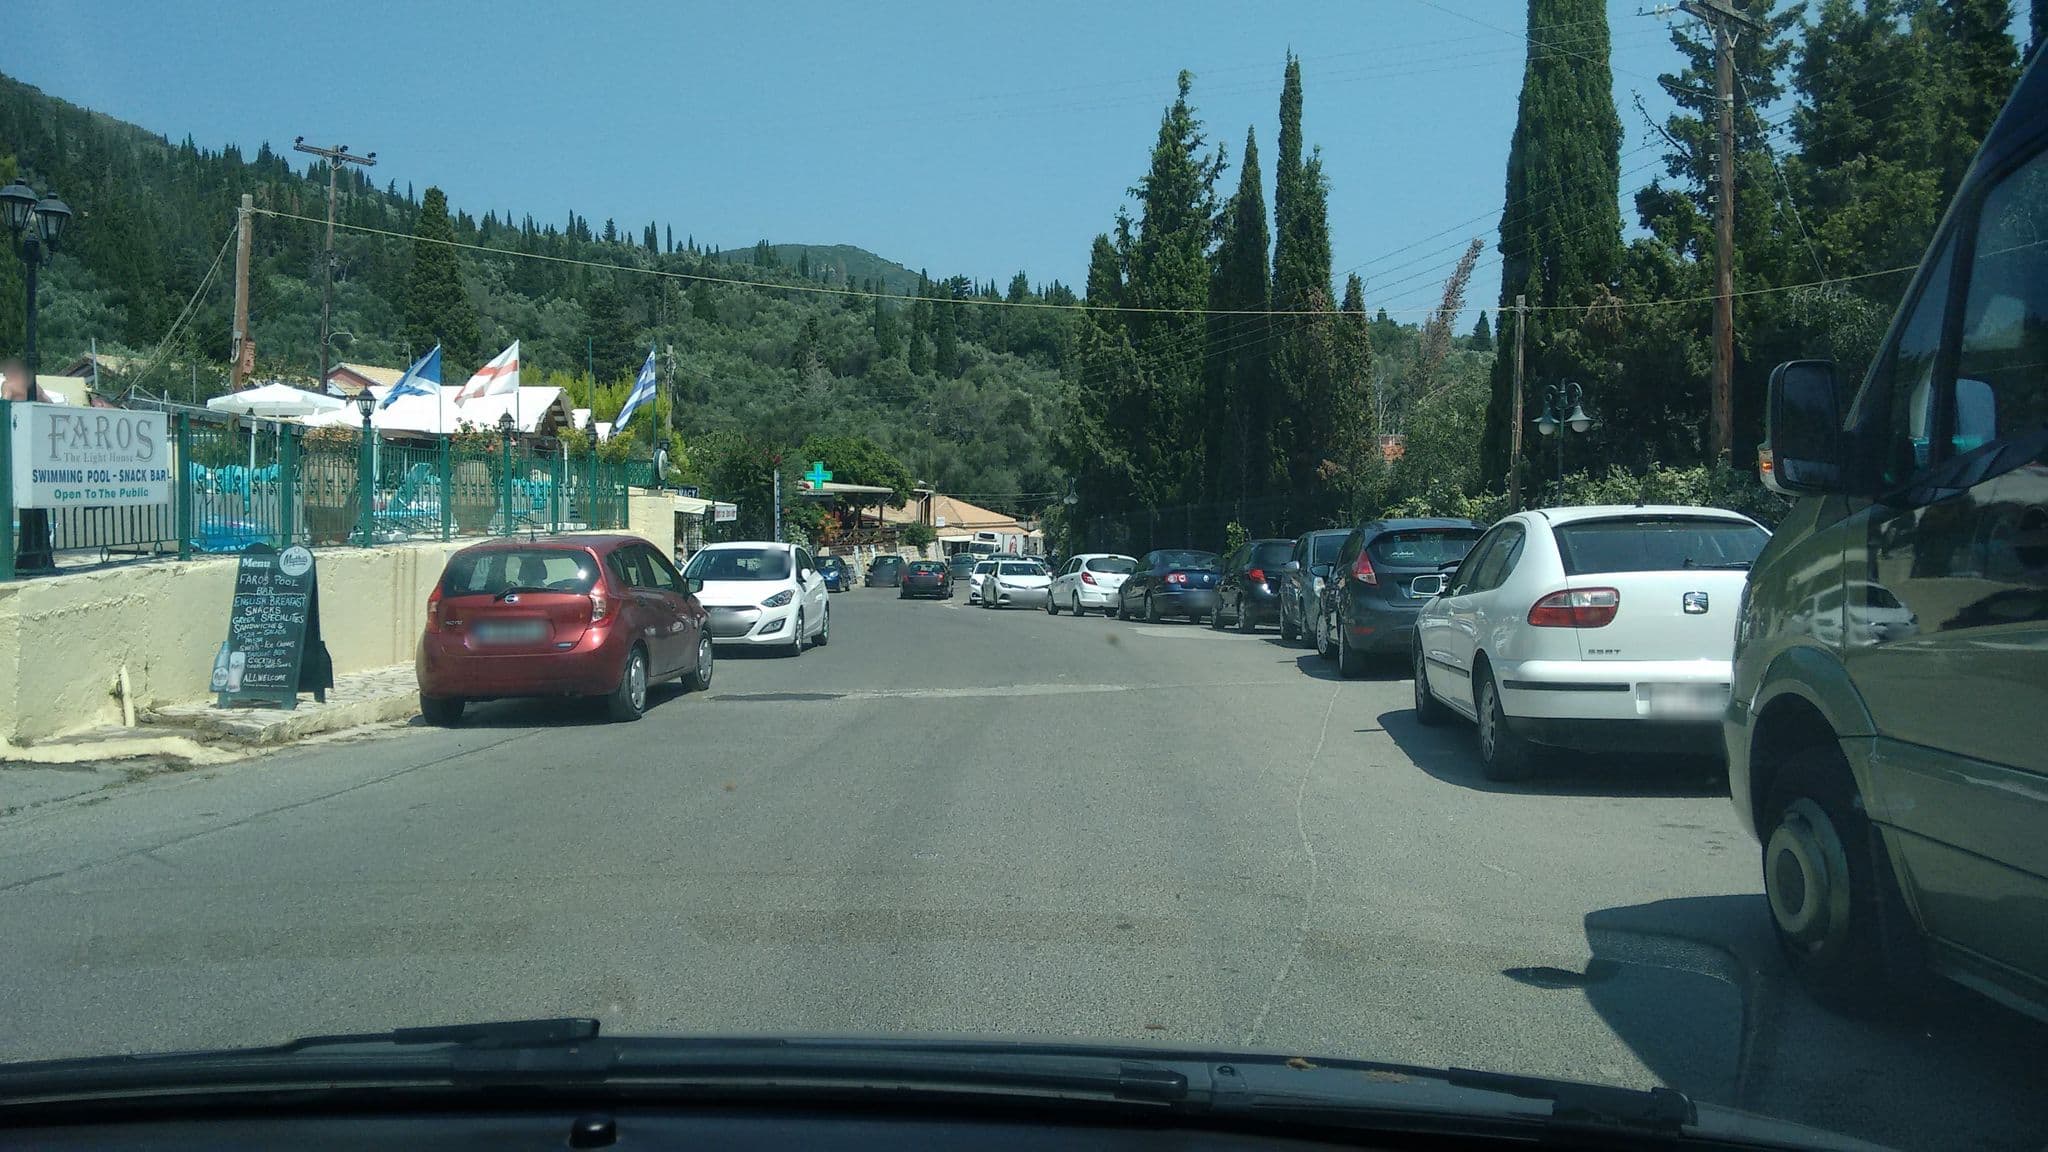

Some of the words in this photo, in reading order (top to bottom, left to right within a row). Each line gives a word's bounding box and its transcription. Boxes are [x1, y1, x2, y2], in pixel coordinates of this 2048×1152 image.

[48, 415, 154, 461] FAROS
[64, 452, 80, 462] The
[32, 469, 83, 483] SWIMMING
[87, 469, 111, 483] POOL
[119, 468, 147, 482] SNACK
[150, 469, 167, 482] BAR
[54, 488, 81, 501] Open
[85, 488, 97, 499] To
[98, 488, 116, 499] The
[119, 487, 149, 498] Public
[241, 557, 271, 568] Menu
[239, 573, 269, 585] FAROS
[274, 574, 299, 586] POOL
[256, 586, 274, 596] BAR
[245, 606, 281, 617] SNACKS
